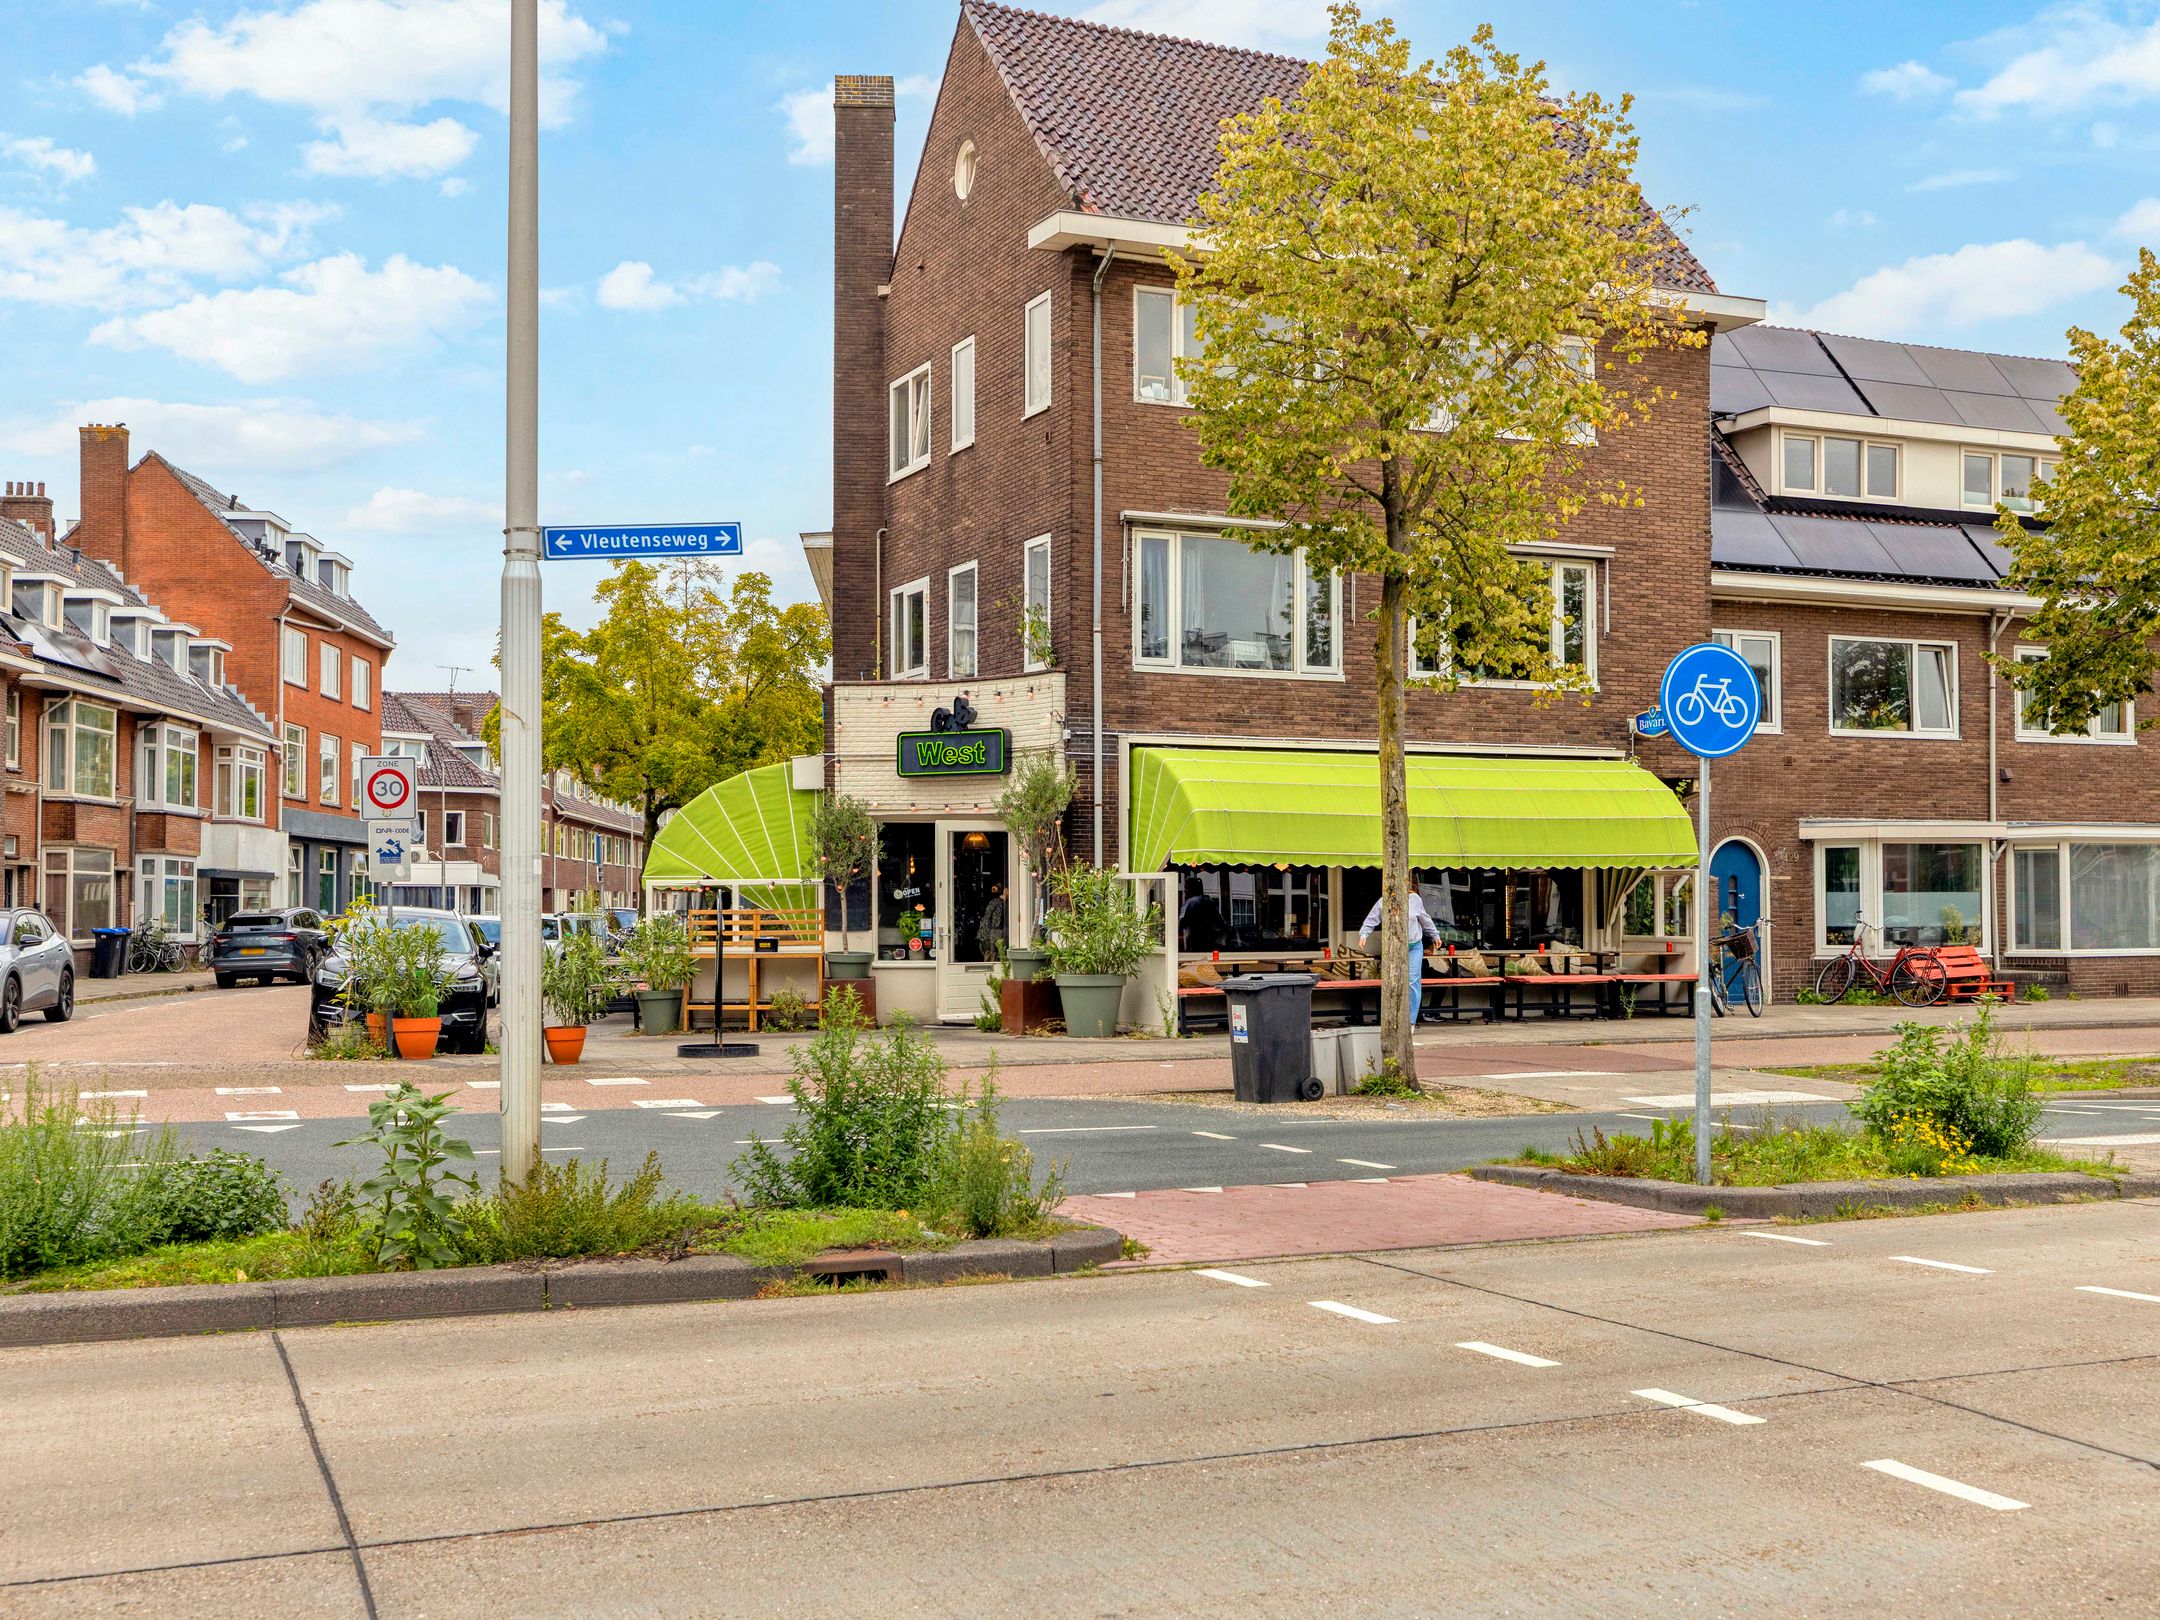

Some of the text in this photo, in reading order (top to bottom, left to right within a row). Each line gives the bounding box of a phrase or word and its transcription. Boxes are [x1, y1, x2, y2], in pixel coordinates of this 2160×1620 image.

[580, 533, 708, 550] Vleutenseweg
[1639, 717, 1667, 731] Bavari
[917, 740, 986, 765] West
[377, 760, 399, 768] ZONE
[375, 781, 403, 797] 30
[902, 887, 920, 896] OPEN
